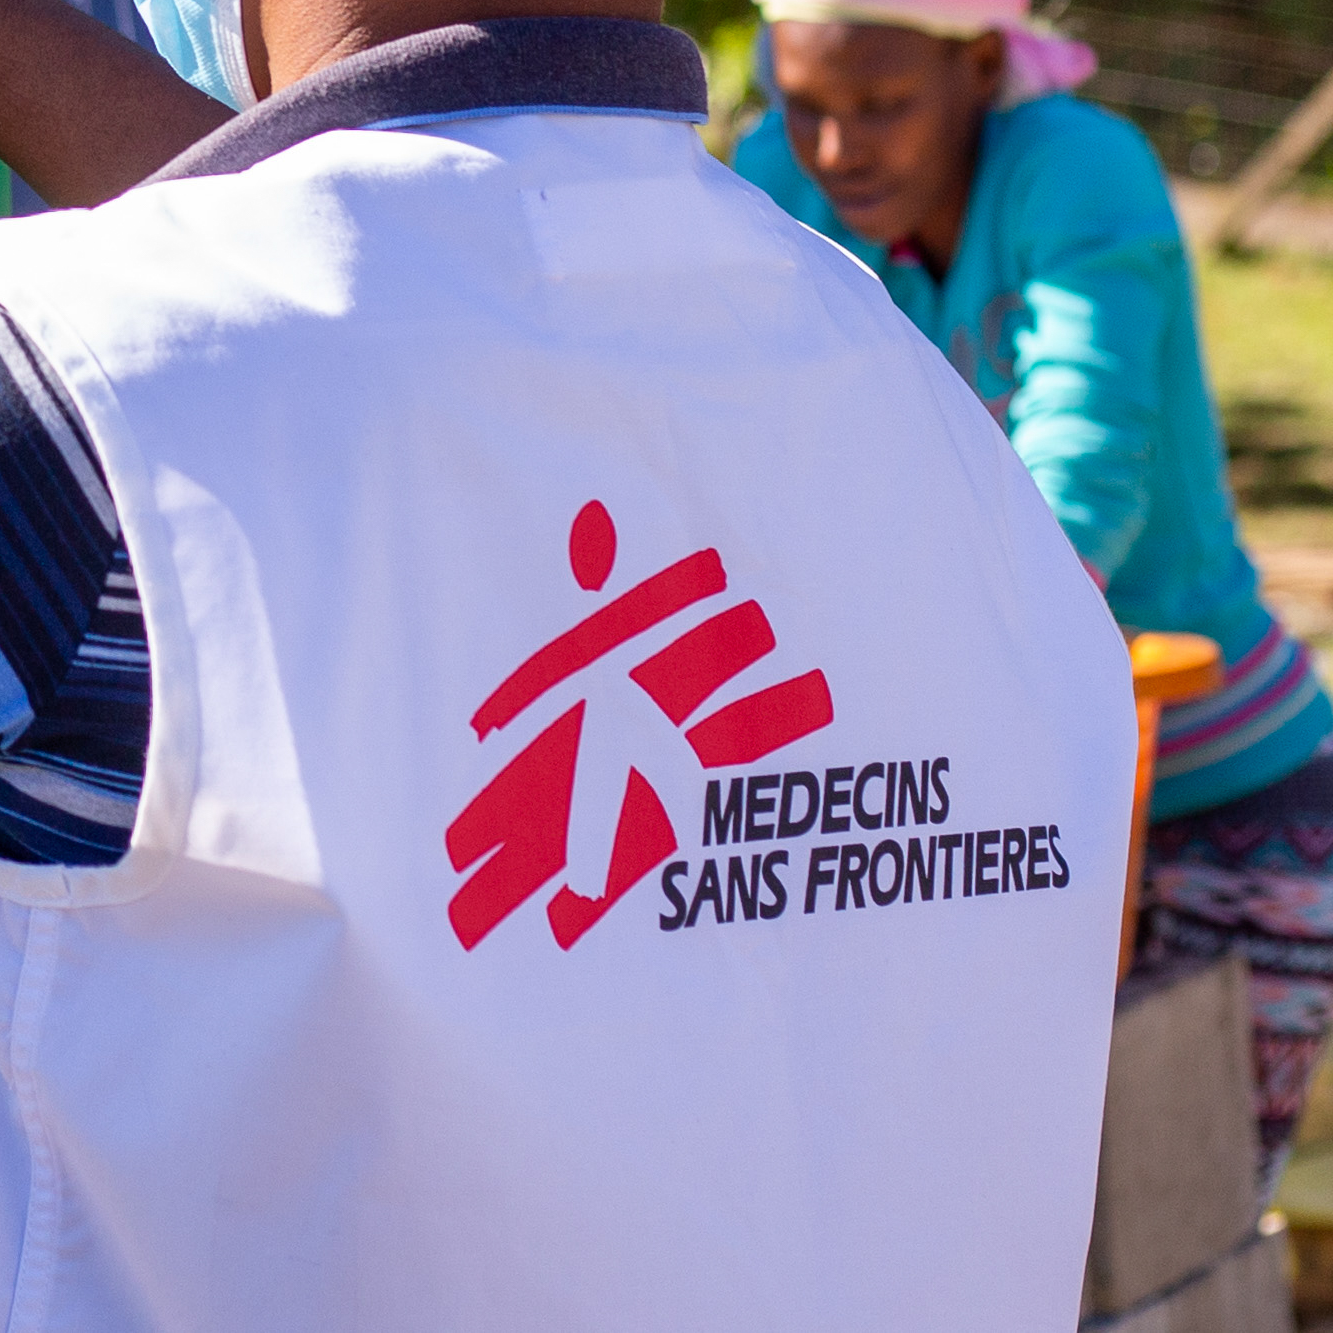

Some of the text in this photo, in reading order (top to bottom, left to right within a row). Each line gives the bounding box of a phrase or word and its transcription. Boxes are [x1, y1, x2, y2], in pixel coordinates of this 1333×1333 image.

[702, 756, 949, 846] MEDECINS
[659, 824, 1070, 931] SANS FRONTIERES
